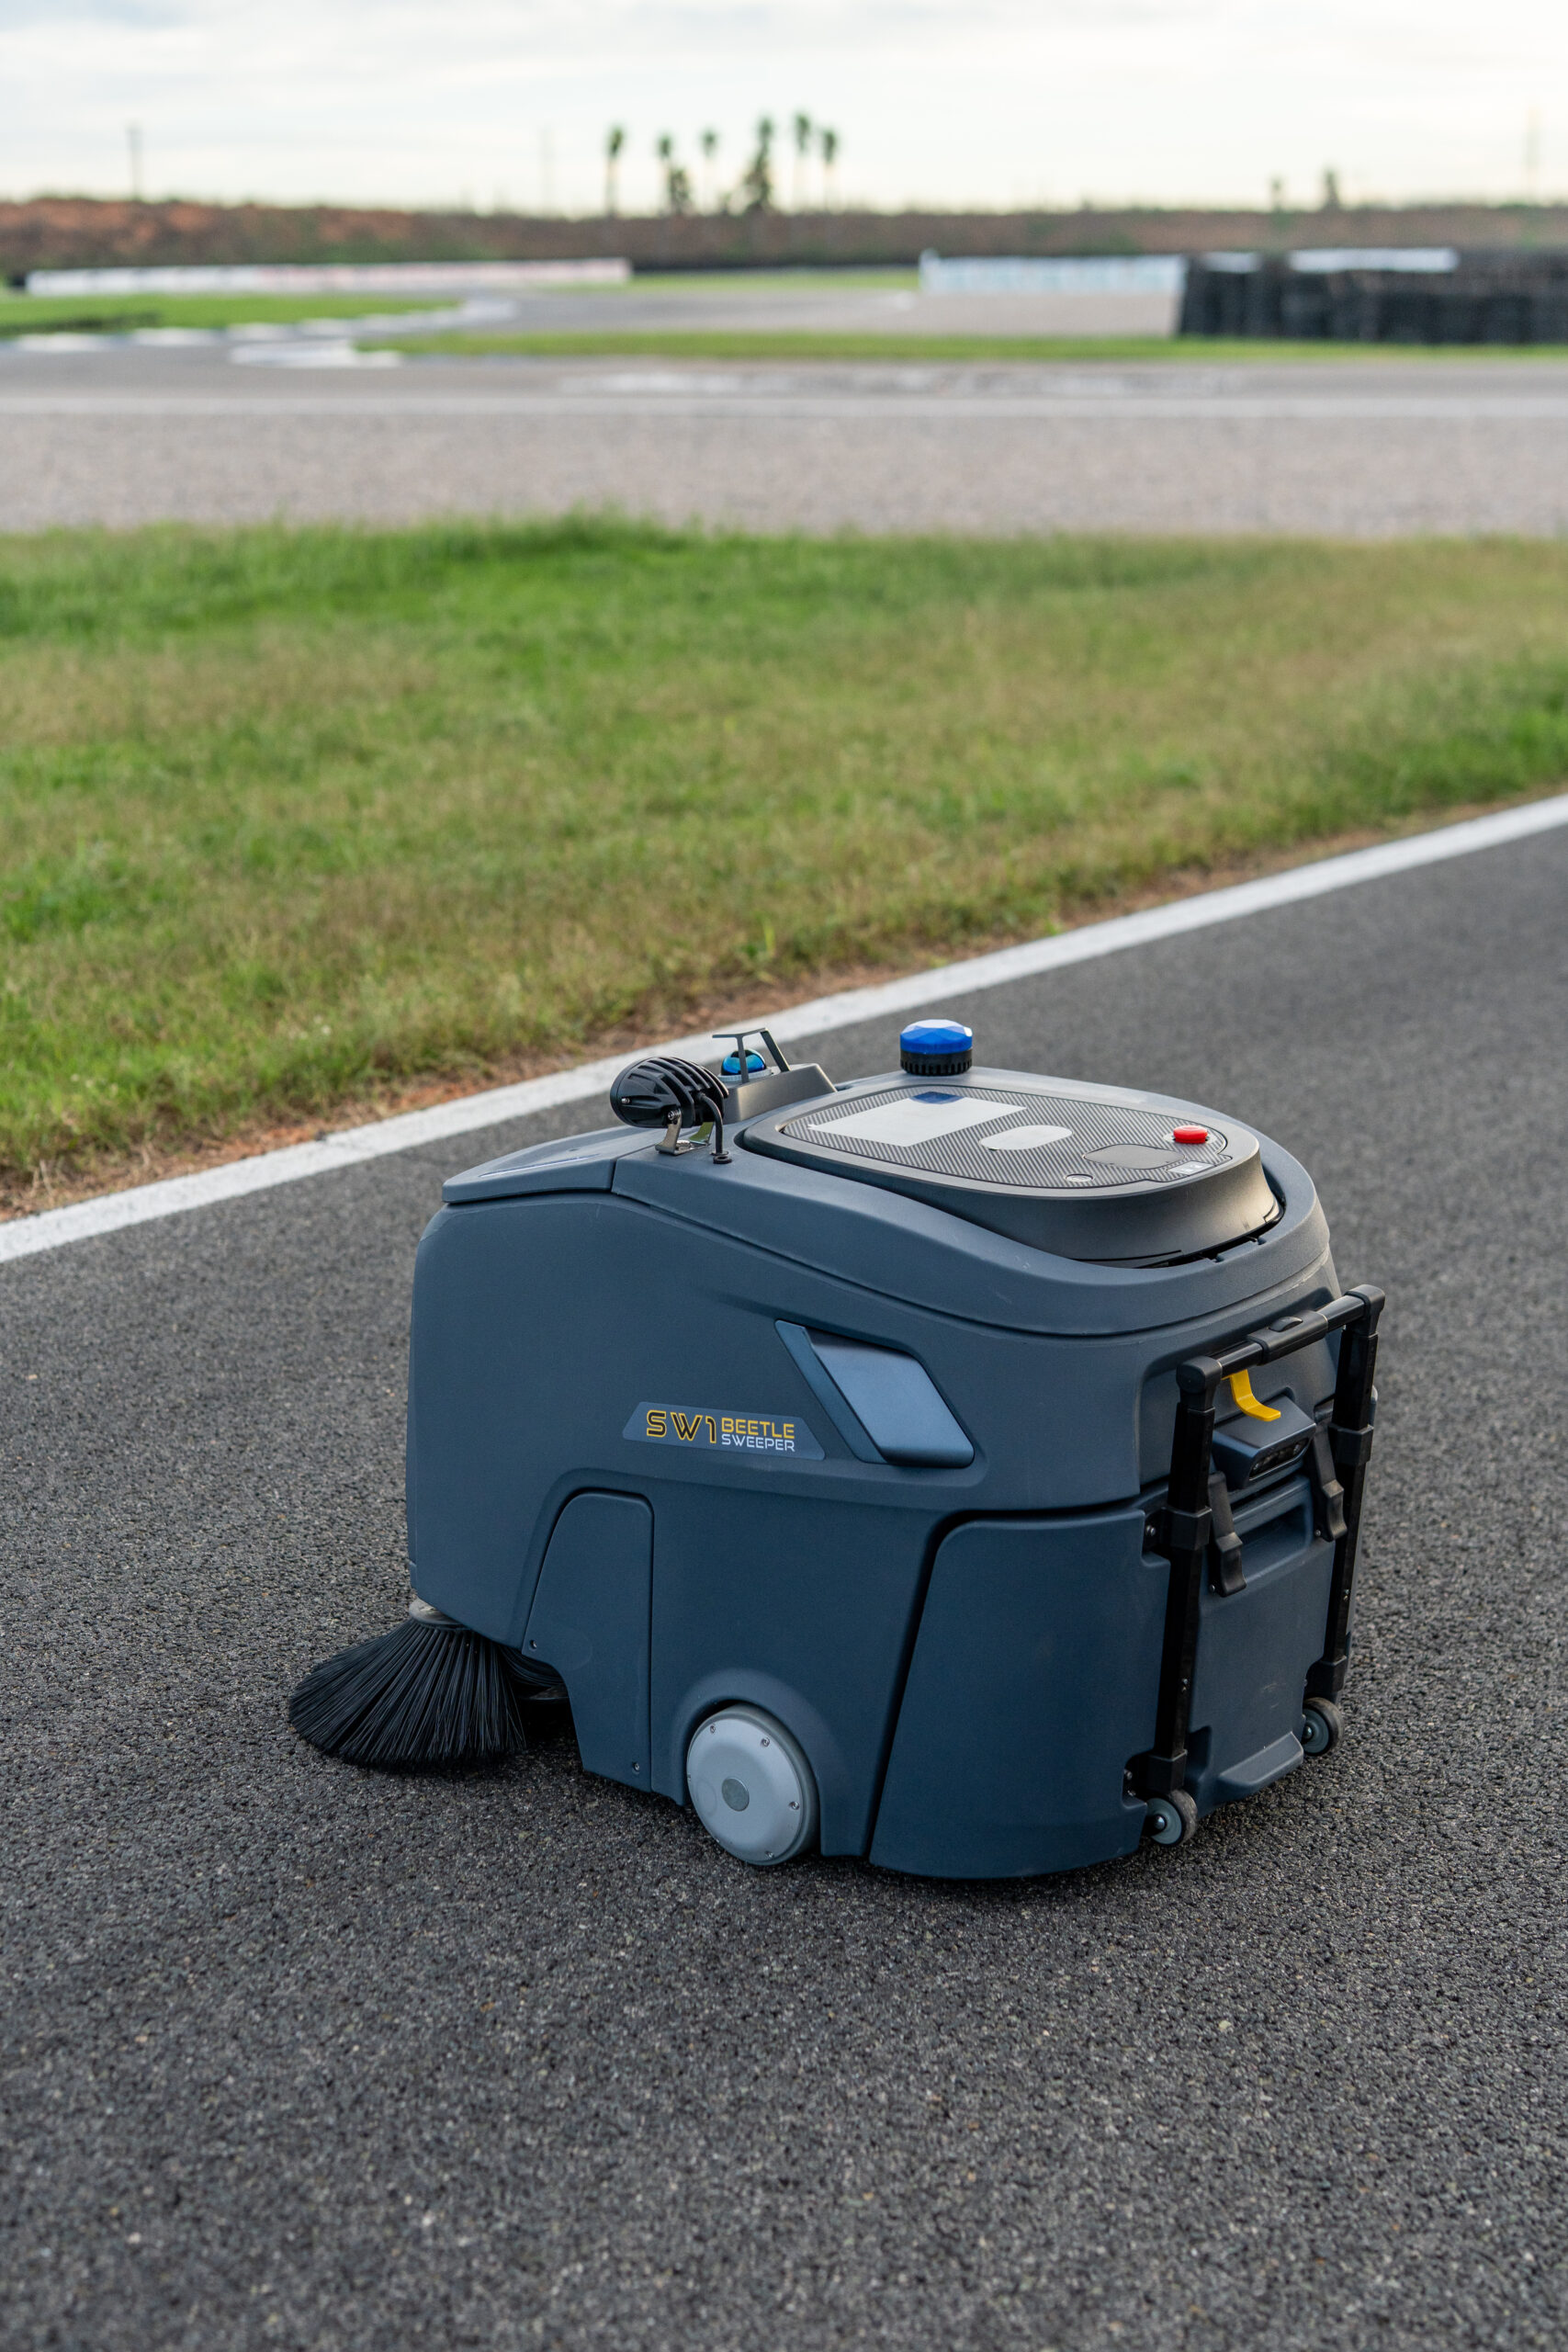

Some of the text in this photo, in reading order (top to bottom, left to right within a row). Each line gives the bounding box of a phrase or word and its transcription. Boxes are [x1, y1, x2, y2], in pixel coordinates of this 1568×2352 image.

[647, 1409, 716, 1443] SW1
[721, 1417, 795, 1439] BEETLE
[721, 1433, 795, 1452] SWEEPER
